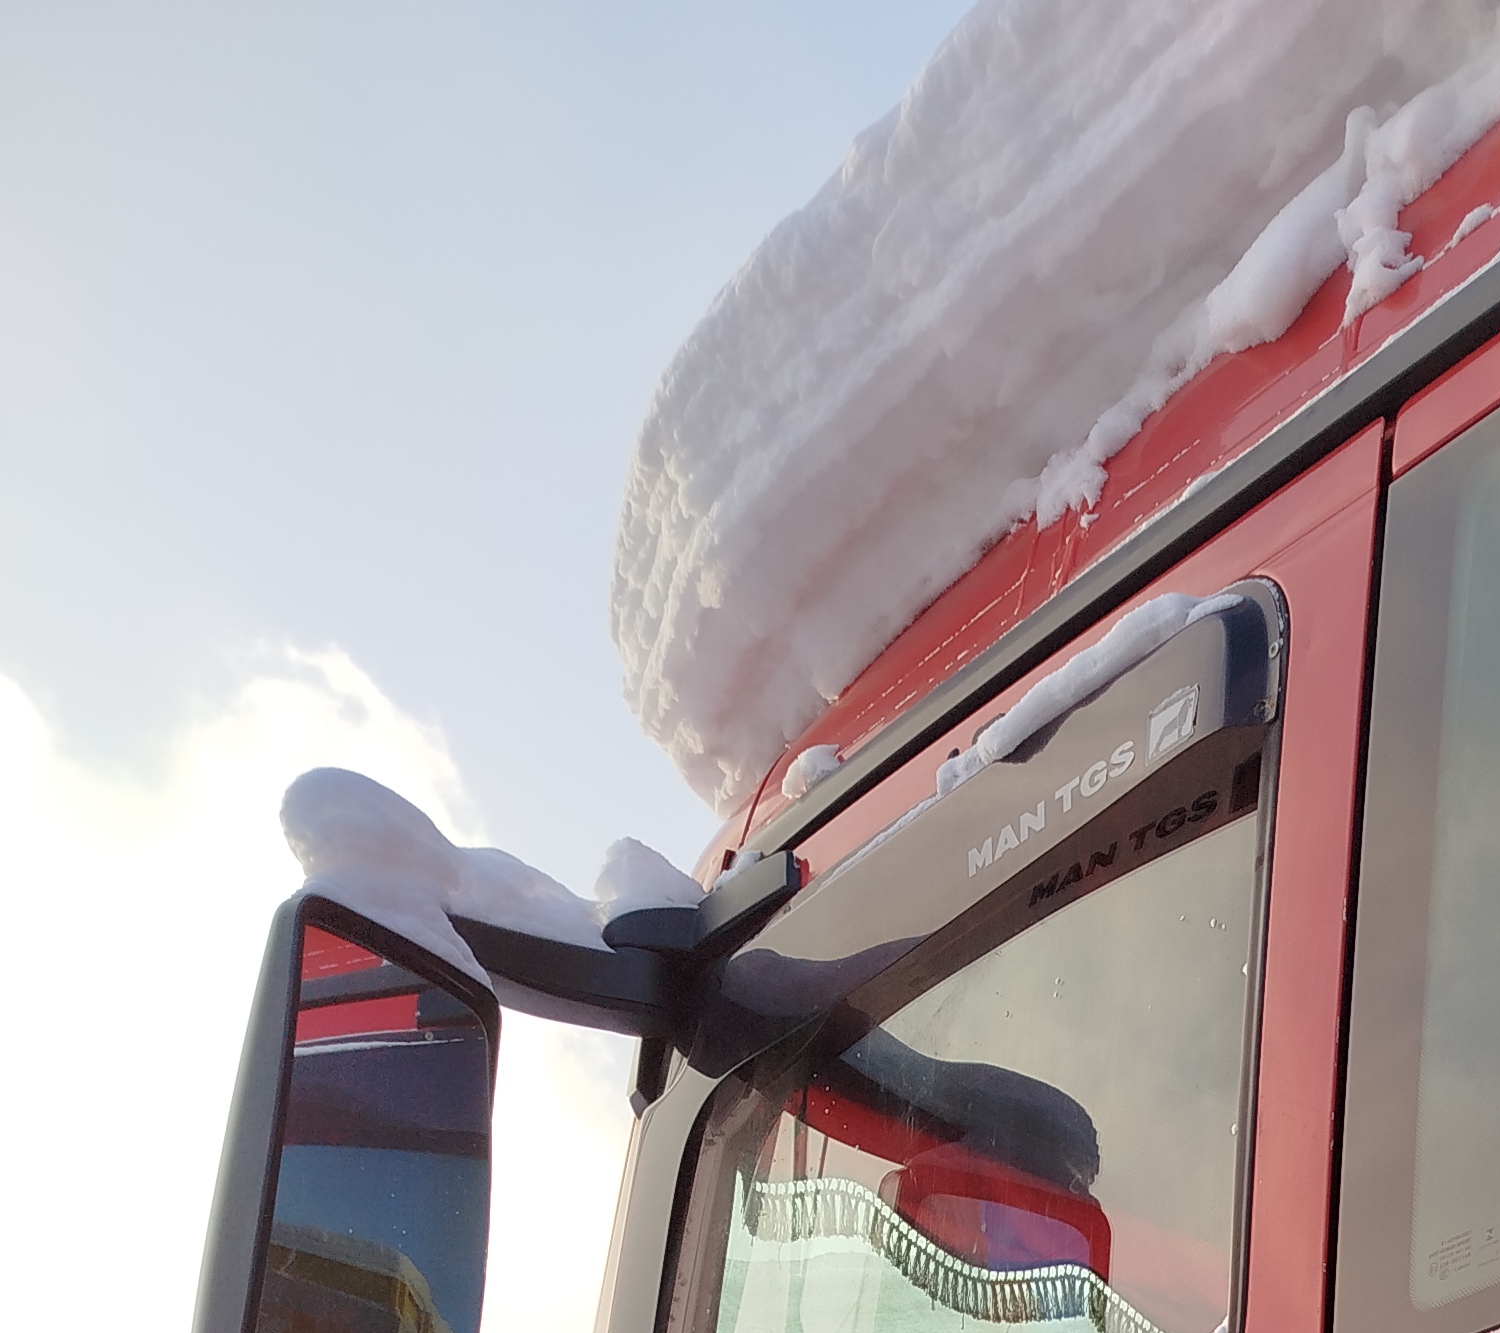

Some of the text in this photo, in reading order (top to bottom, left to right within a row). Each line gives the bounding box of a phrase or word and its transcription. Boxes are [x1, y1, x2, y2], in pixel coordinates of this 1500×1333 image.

[967, 740, 1135, 878] MAN TGS
[1128, 789, 1218, 851] TGS
